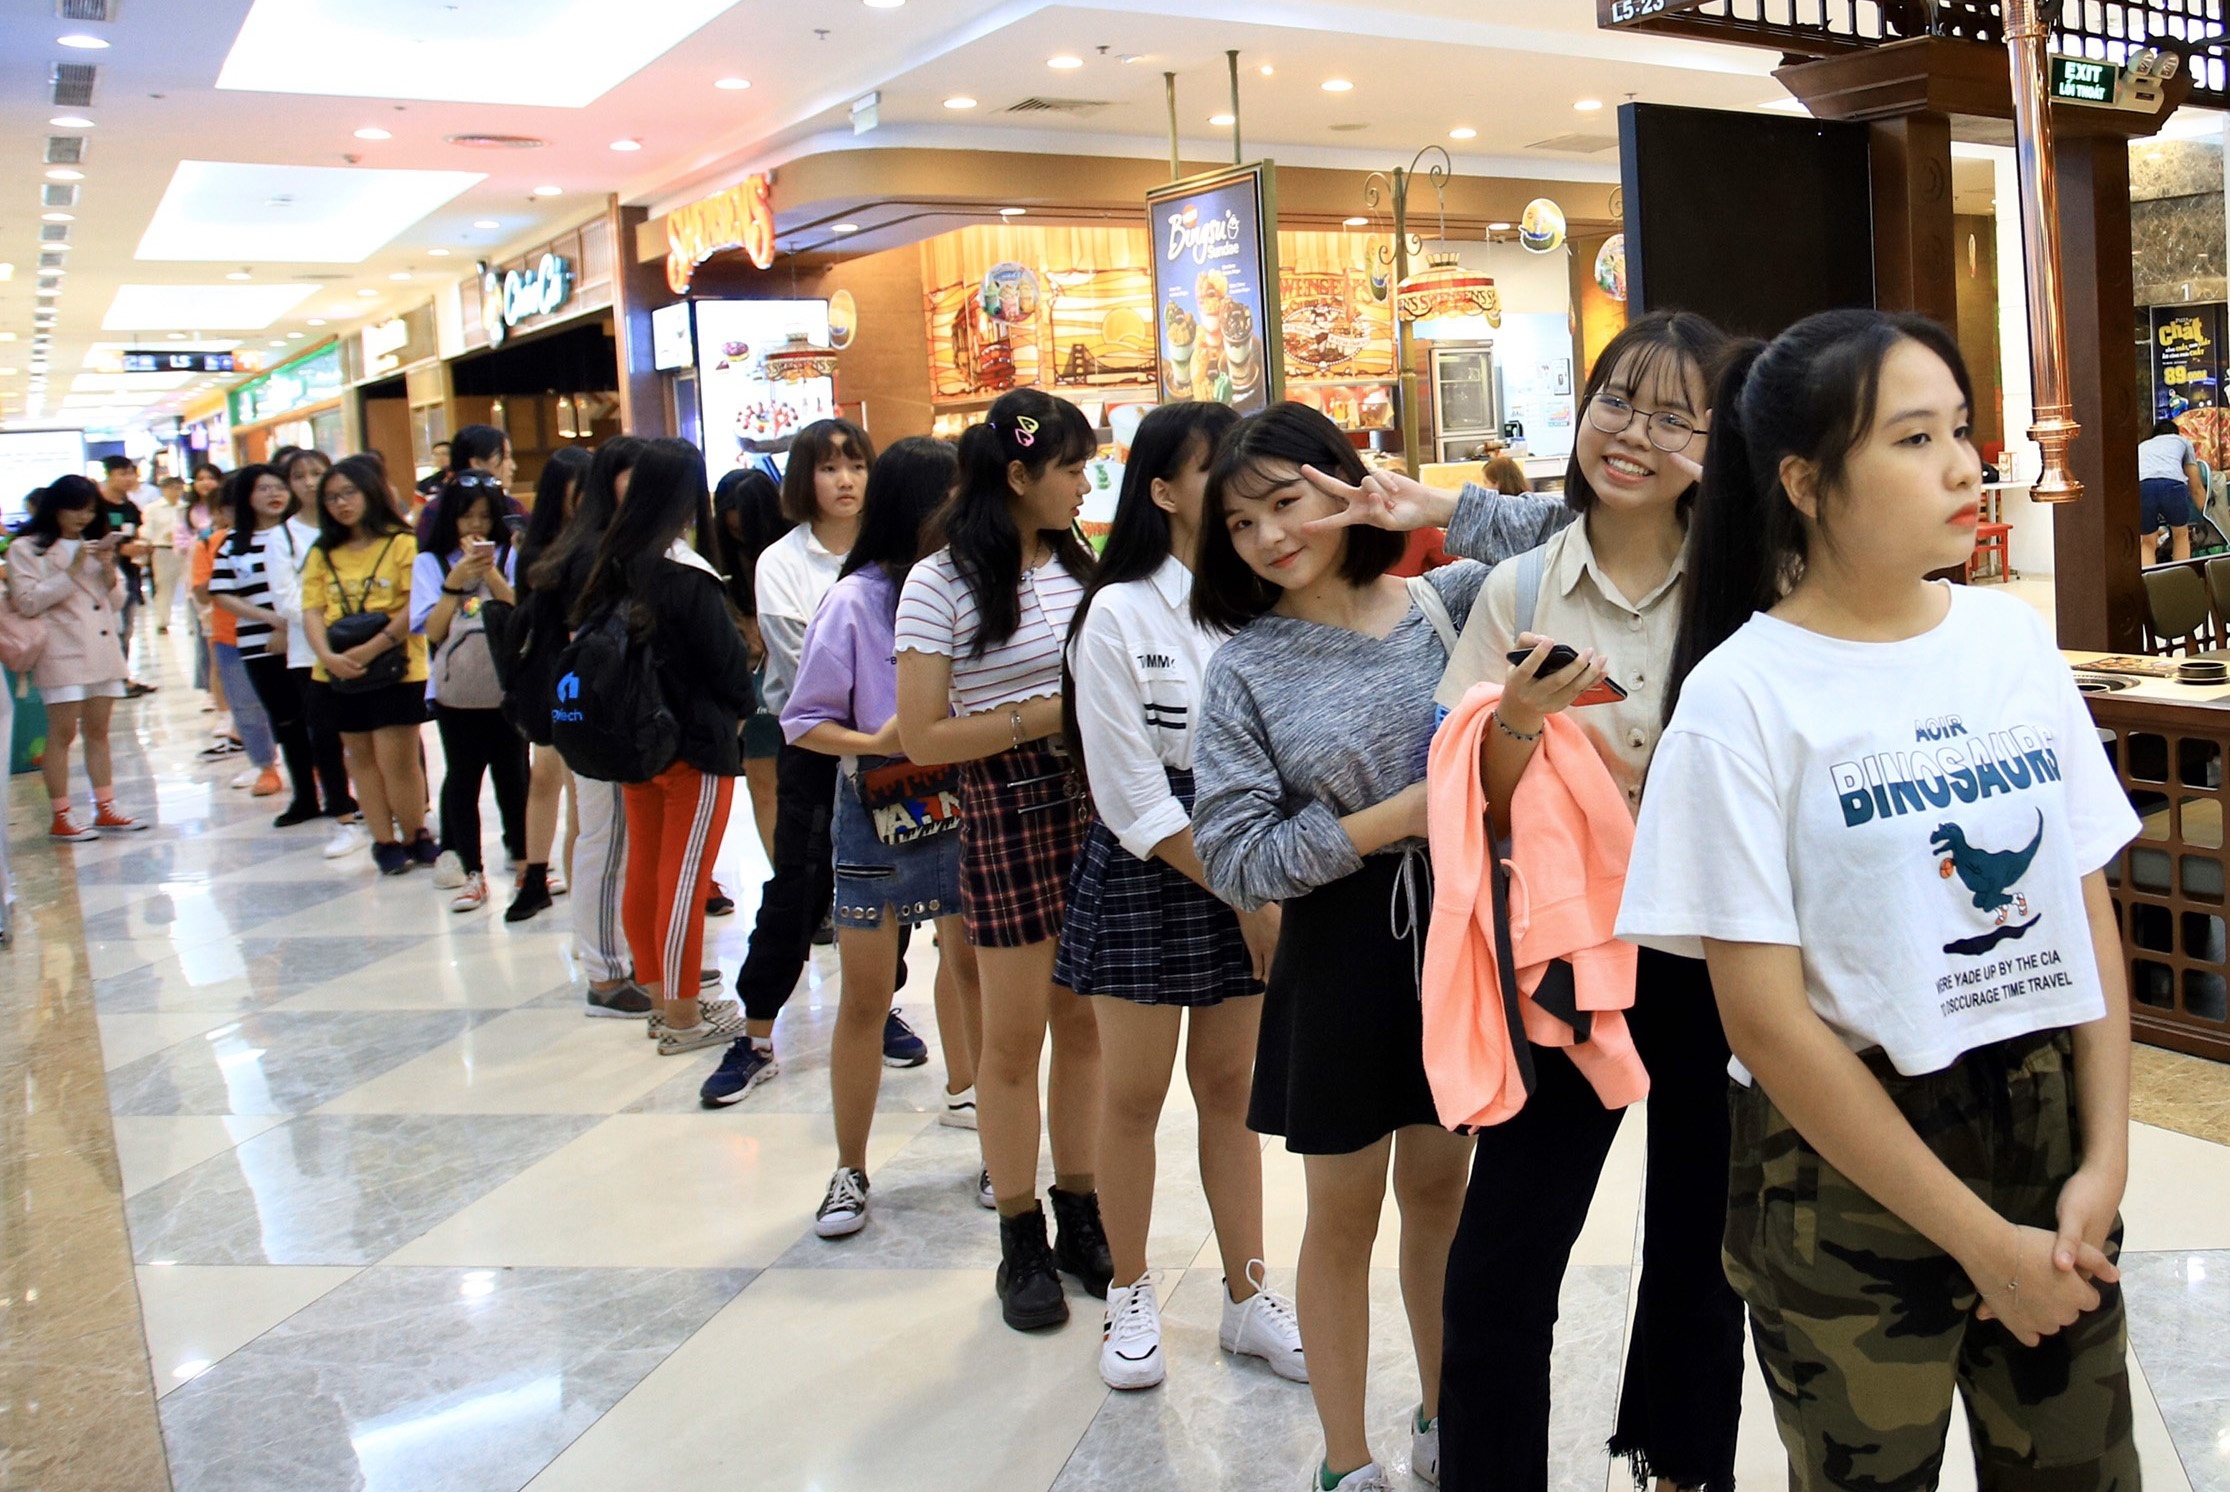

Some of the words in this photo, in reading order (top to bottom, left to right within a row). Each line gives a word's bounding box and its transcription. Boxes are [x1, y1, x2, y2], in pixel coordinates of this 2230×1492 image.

[2065, 61, 2103, 83] EXIT
[2076, 84, 2106, 100] THOÁT
[1168, 213, 1227, 265] Bingsu
[1207, 241, 1240, 260] Sundae
[2181, 283, 2191, 301] 1
[1914, 714, 1969, 743] AOIR
[1954, 968, 1982, 987] YADE
[1983, 964, 1998, 981] UP
[1999, 959, 2014, 977] BY
[2014, 954, 2039, 972] THE
[2039, 949, 2062, 966] CIA
[2001, 980, 2027, 1000] TIME
[2027, 971, 2074, 993] TRAVEL
